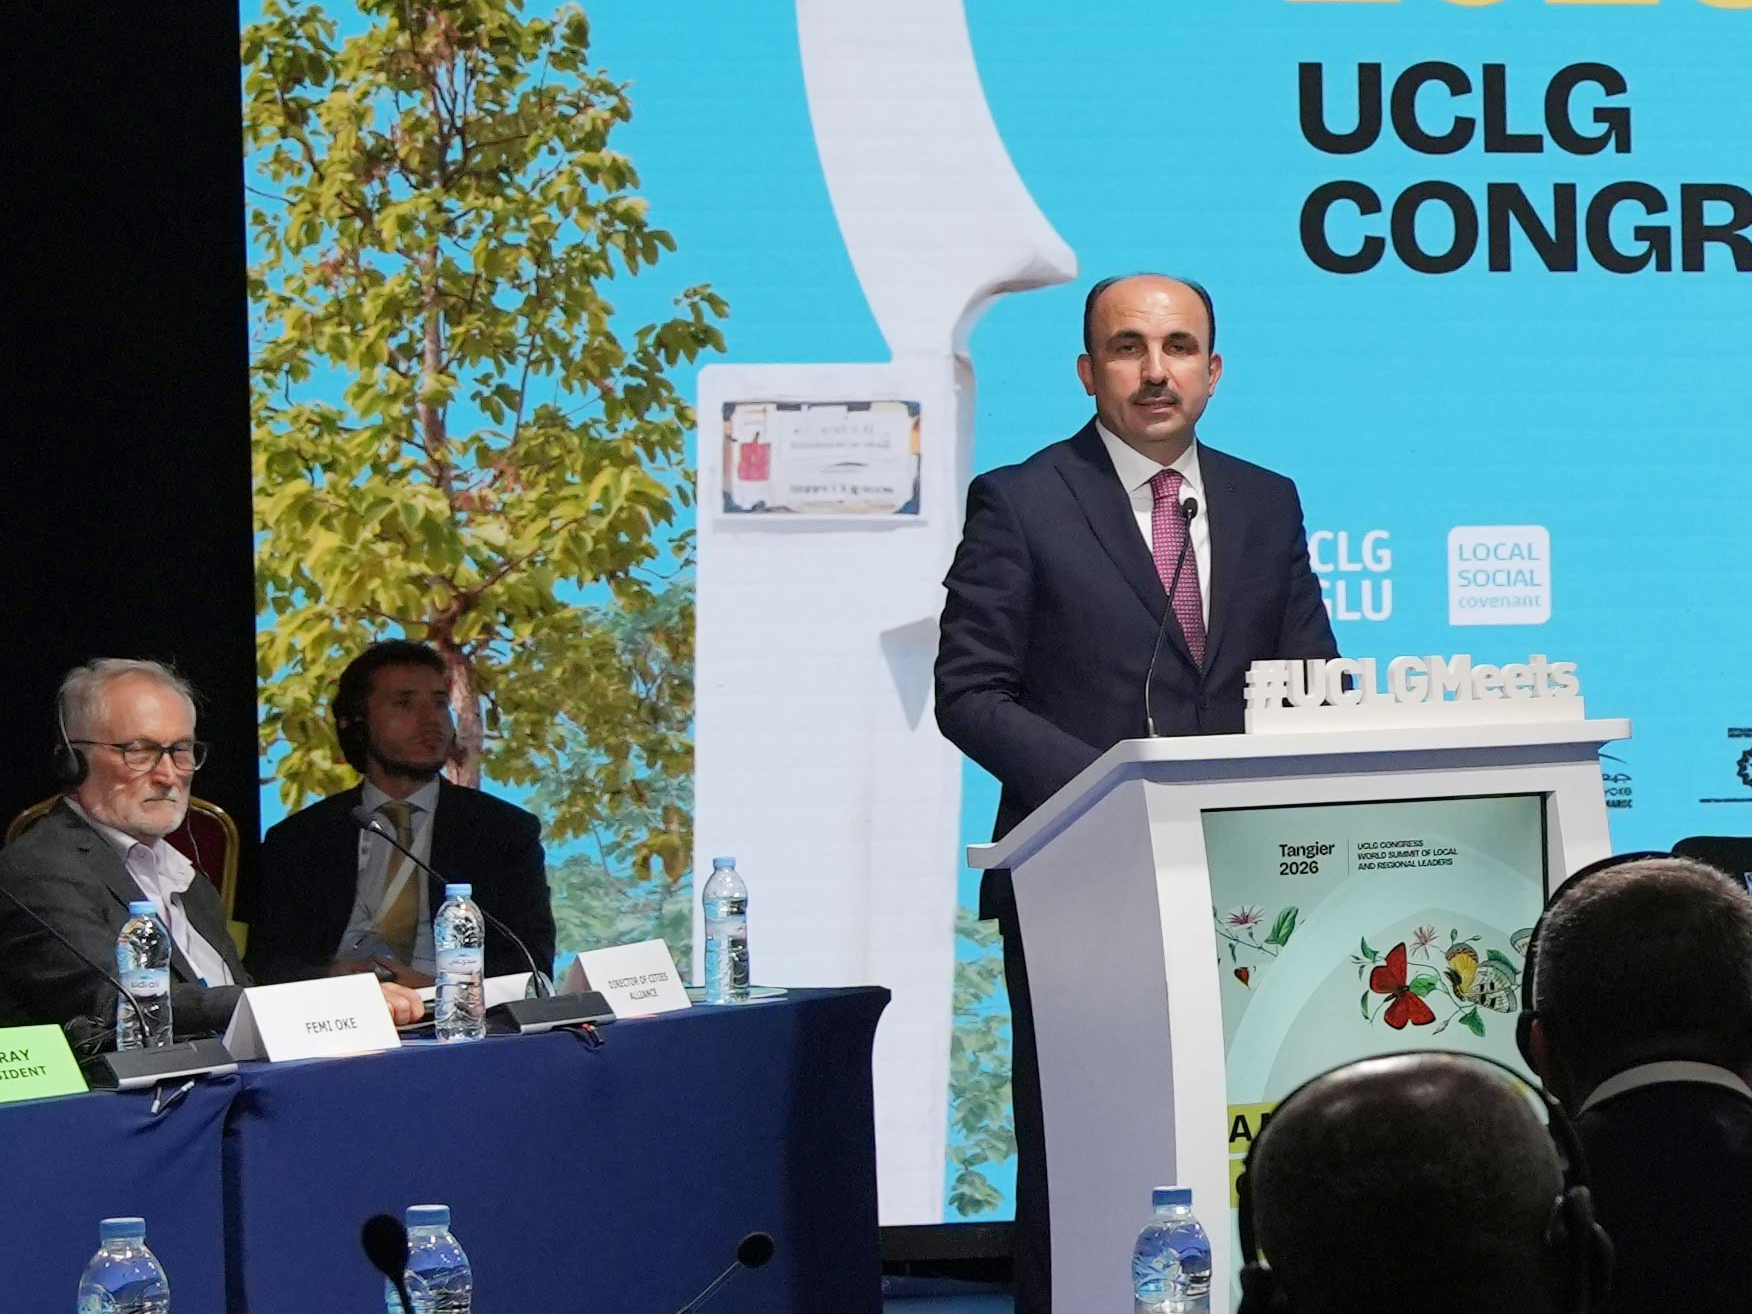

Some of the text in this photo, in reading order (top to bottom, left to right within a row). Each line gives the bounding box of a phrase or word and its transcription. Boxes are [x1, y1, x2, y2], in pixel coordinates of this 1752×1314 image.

[1297, 61, 1632, 156] UCLG
[1308, 530, 1392, 574] CLG
[1459, 542, 1540, 562] LOCAL
[1458, 569, 1541, 588] SOCIAL
[1458, 593, 1542, 608] covenant
[1244, 654, 1580, 709] #UCLGMeets
[1279, 839, 1423, 859] Tangier UCLG CONGRESS
[1280, 847, 1458, 876] 2026 WORLD SUMMIT OF LOCAL
[1358, 858, 1453, 870] AND REGIONAL LEADERS
[305, 1016, 358, 1035] FEMI OKE
